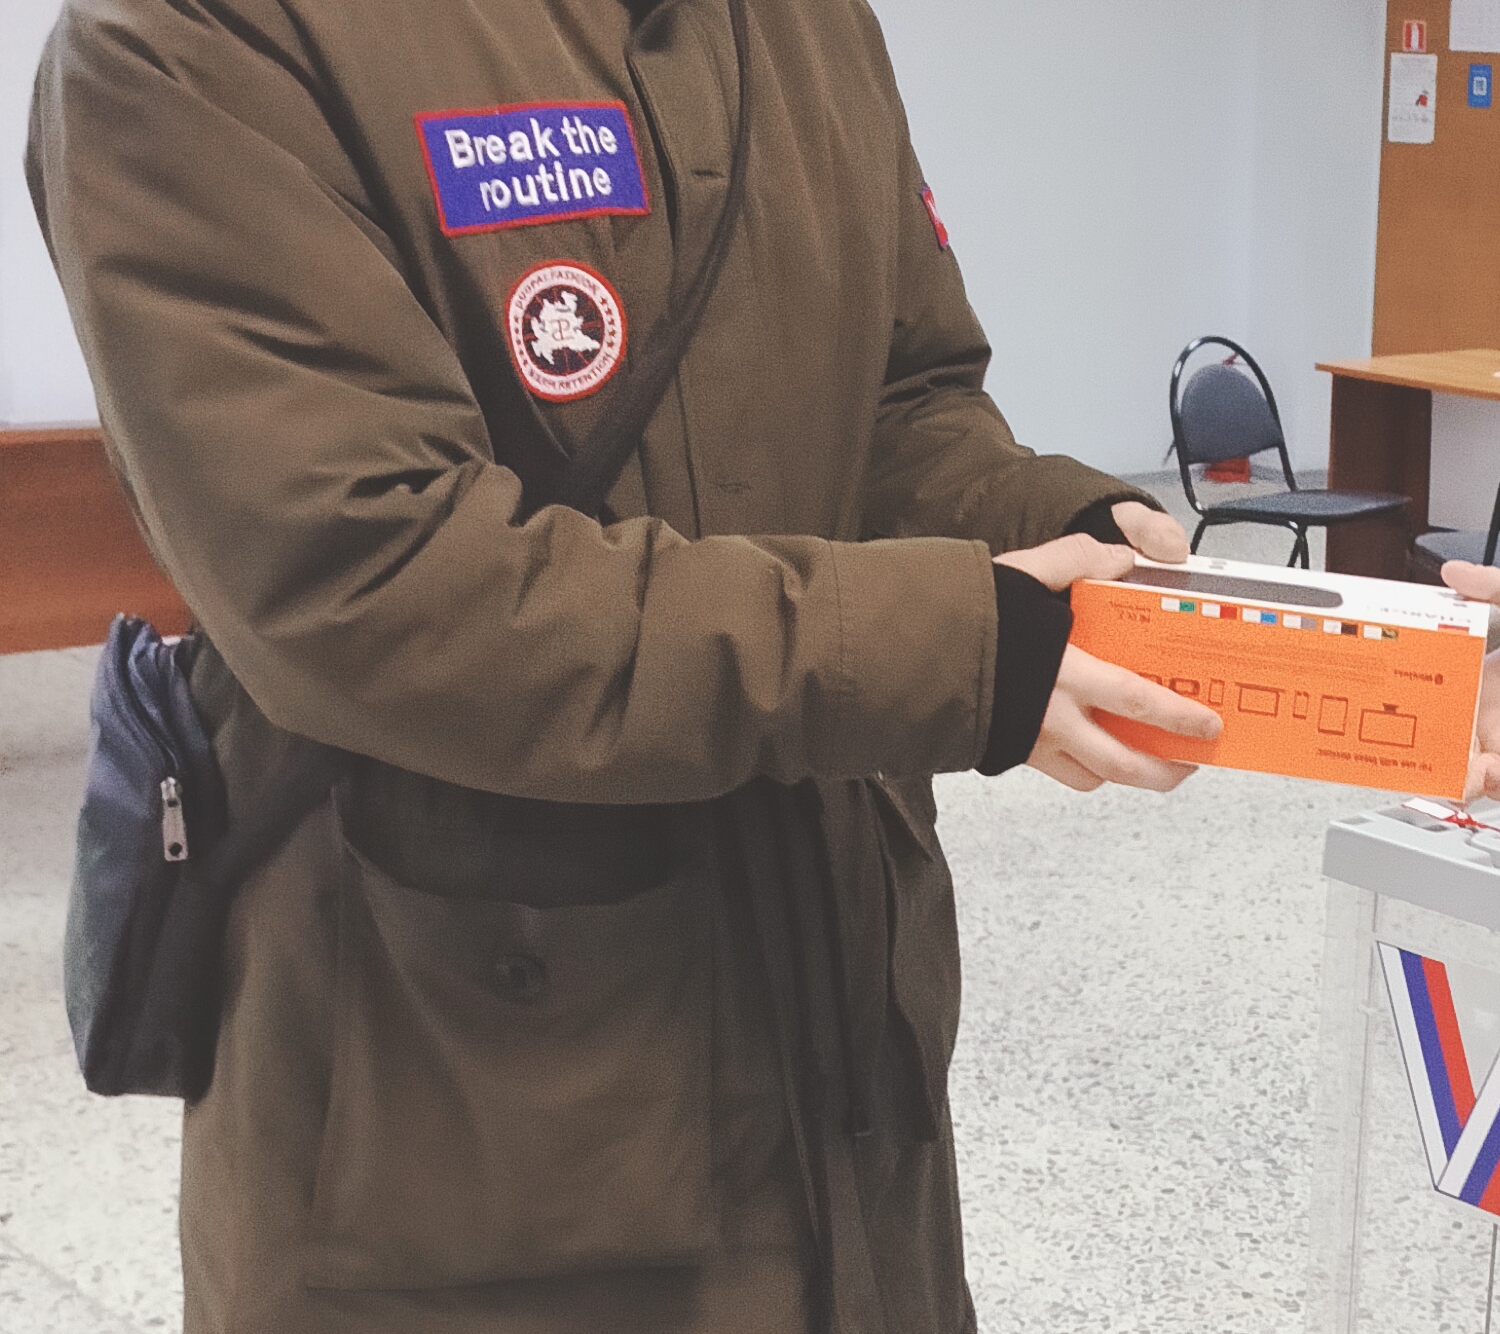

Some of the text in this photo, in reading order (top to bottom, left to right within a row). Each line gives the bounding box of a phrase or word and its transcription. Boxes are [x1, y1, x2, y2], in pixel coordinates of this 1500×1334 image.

[444, 116, 618, 168] Break the
[479, 162, 613, 212] routine
